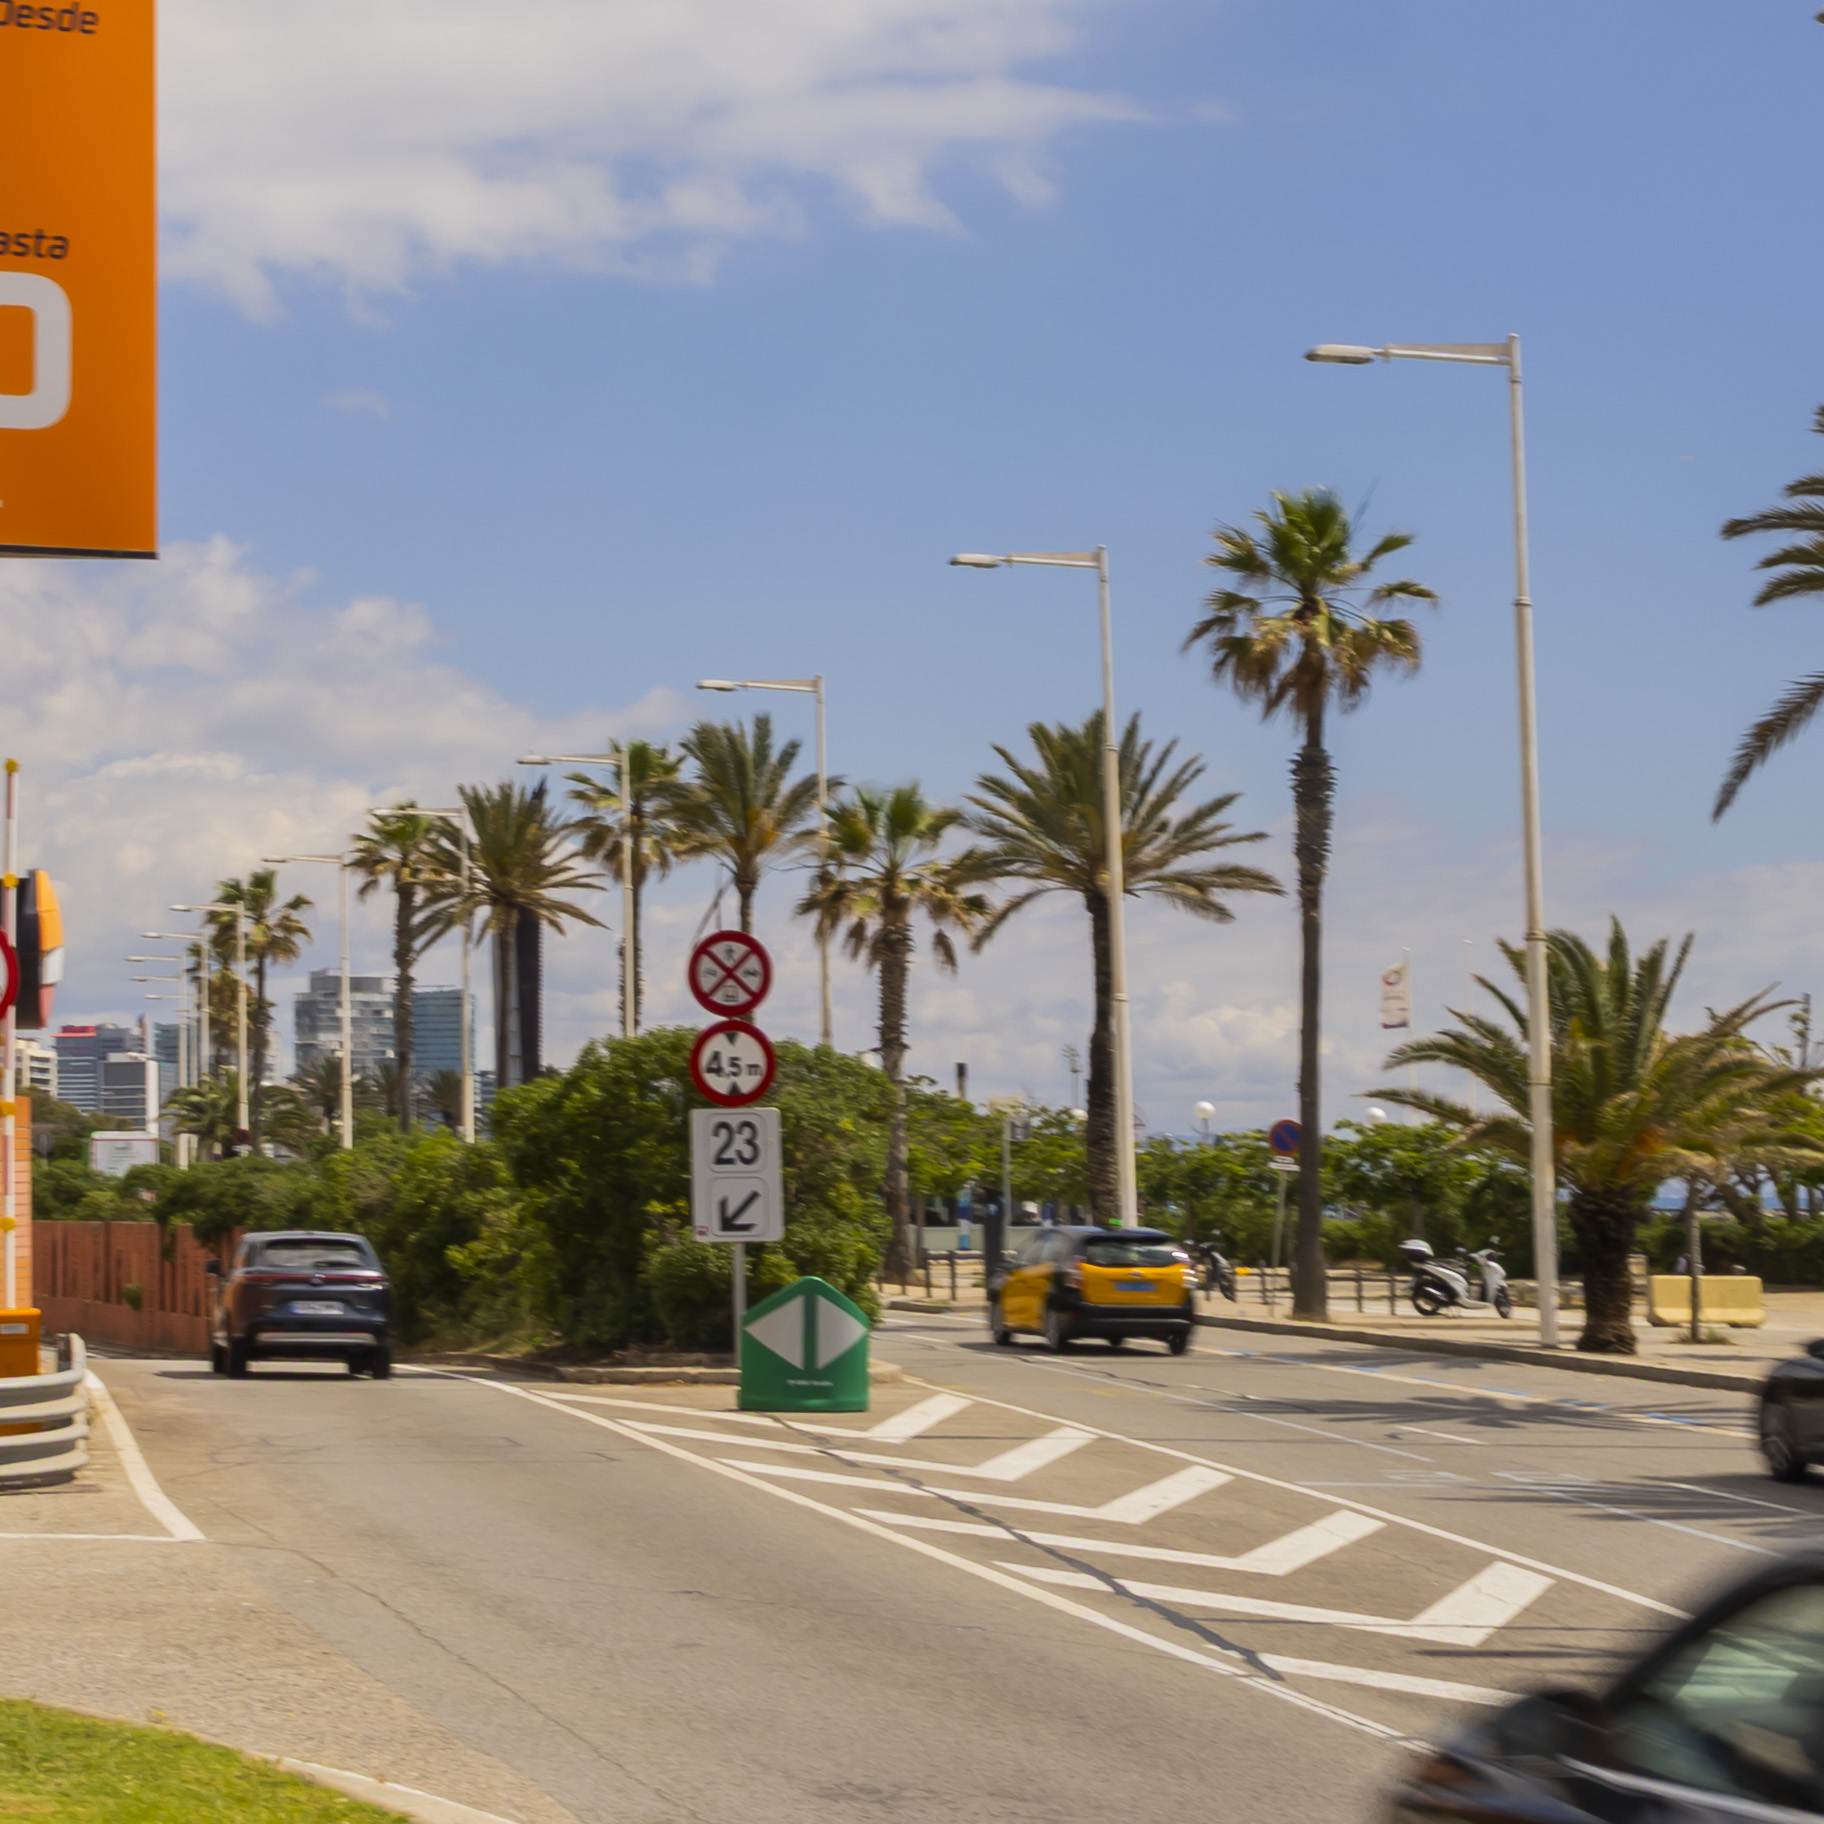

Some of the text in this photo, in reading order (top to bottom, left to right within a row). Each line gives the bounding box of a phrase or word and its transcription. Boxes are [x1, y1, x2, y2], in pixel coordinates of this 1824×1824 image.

[705, 1049, 763, 1076] 4,5 m
[711, 1120, 760, 1166] 23
